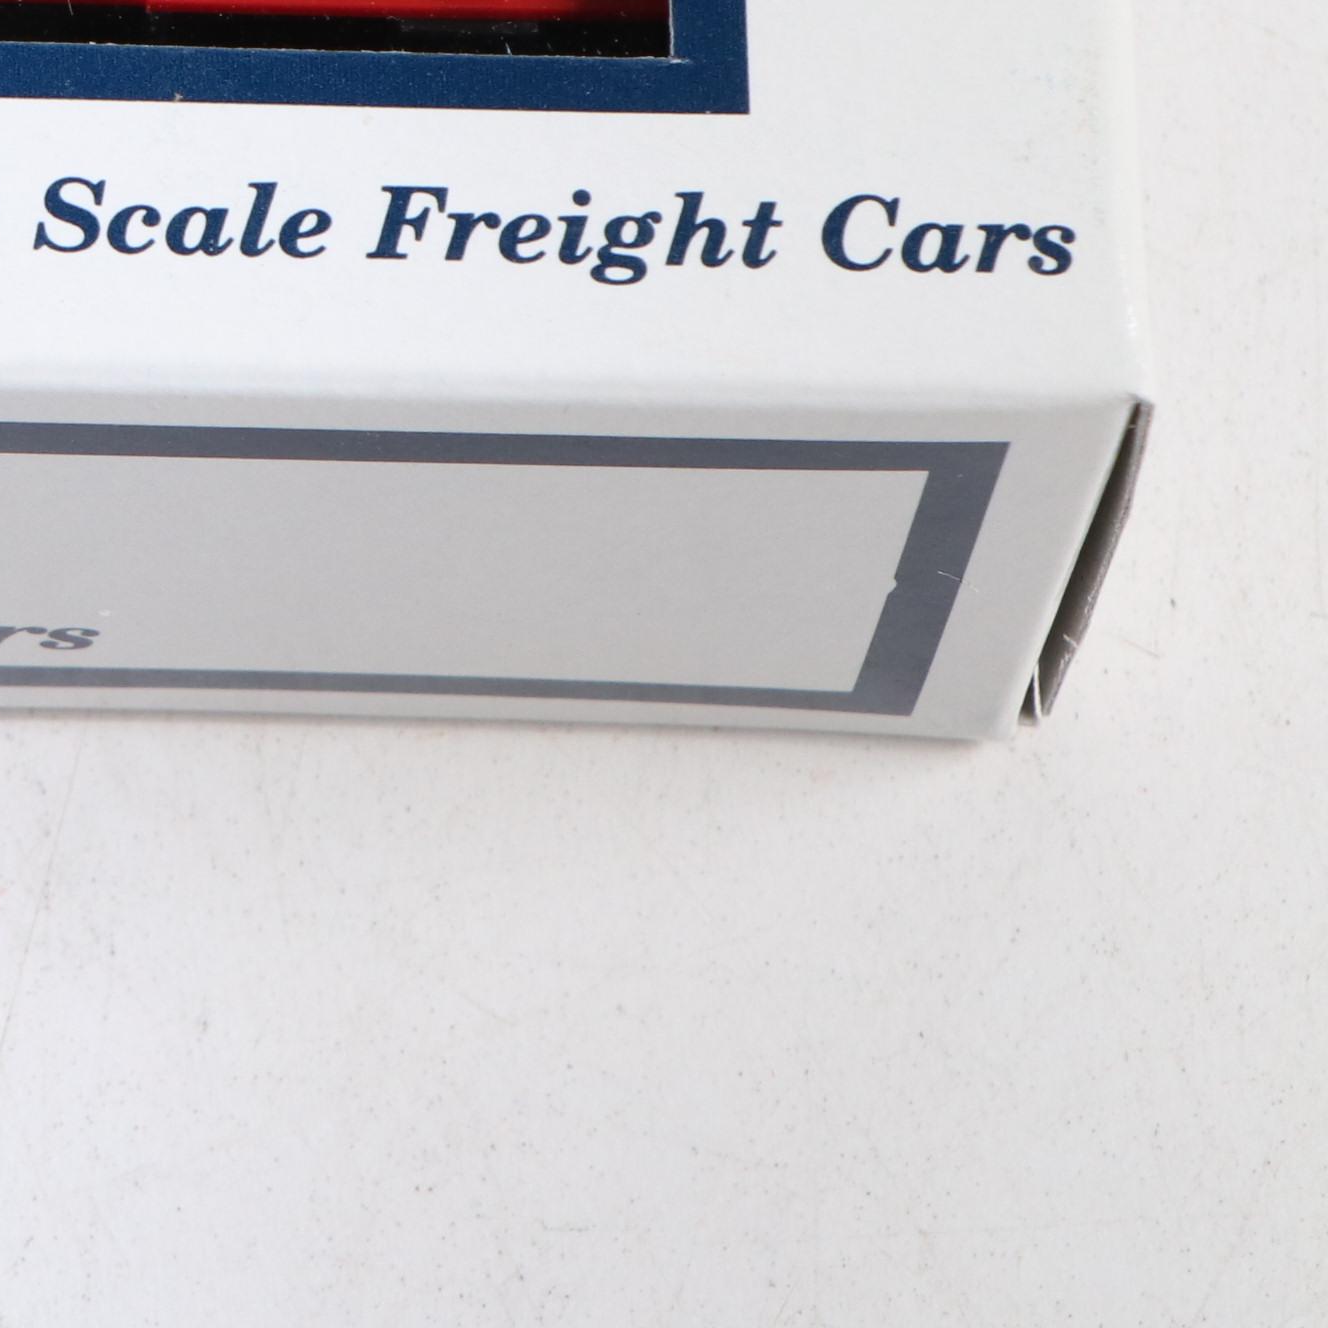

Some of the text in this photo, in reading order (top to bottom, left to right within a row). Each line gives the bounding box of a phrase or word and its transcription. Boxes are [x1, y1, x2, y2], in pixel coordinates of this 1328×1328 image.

[32, 176, 333, 260] Scale
[365, 185, 784, 287] Freight
[820, 193, 1076, 276] Cars
